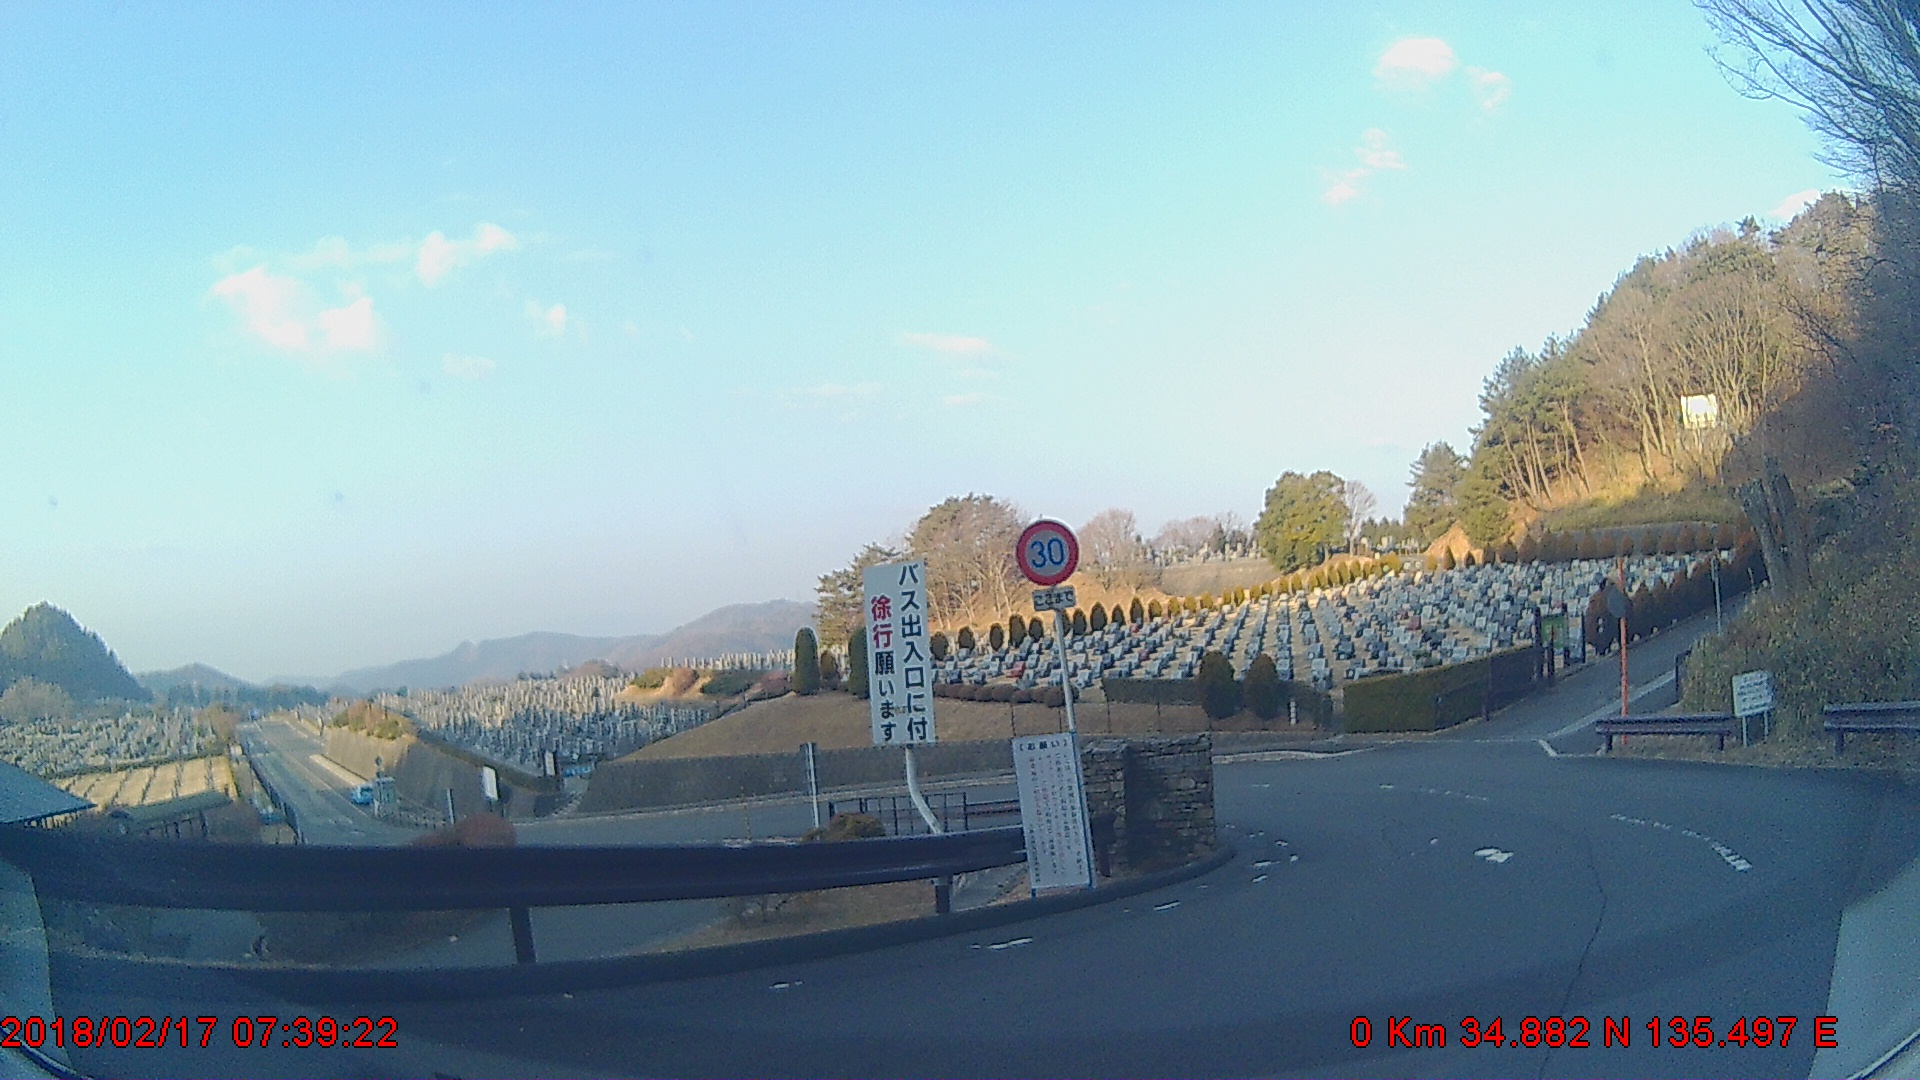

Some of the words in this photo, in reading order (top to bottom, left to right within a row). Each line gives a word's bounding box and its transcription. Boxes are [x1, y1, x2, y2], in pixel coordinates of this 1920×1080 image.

[1031, 538, 1065, 568] 30
[1034, 590, 1074, 607] ここまで
[899, 563, 928, 741] バス出入口に付
